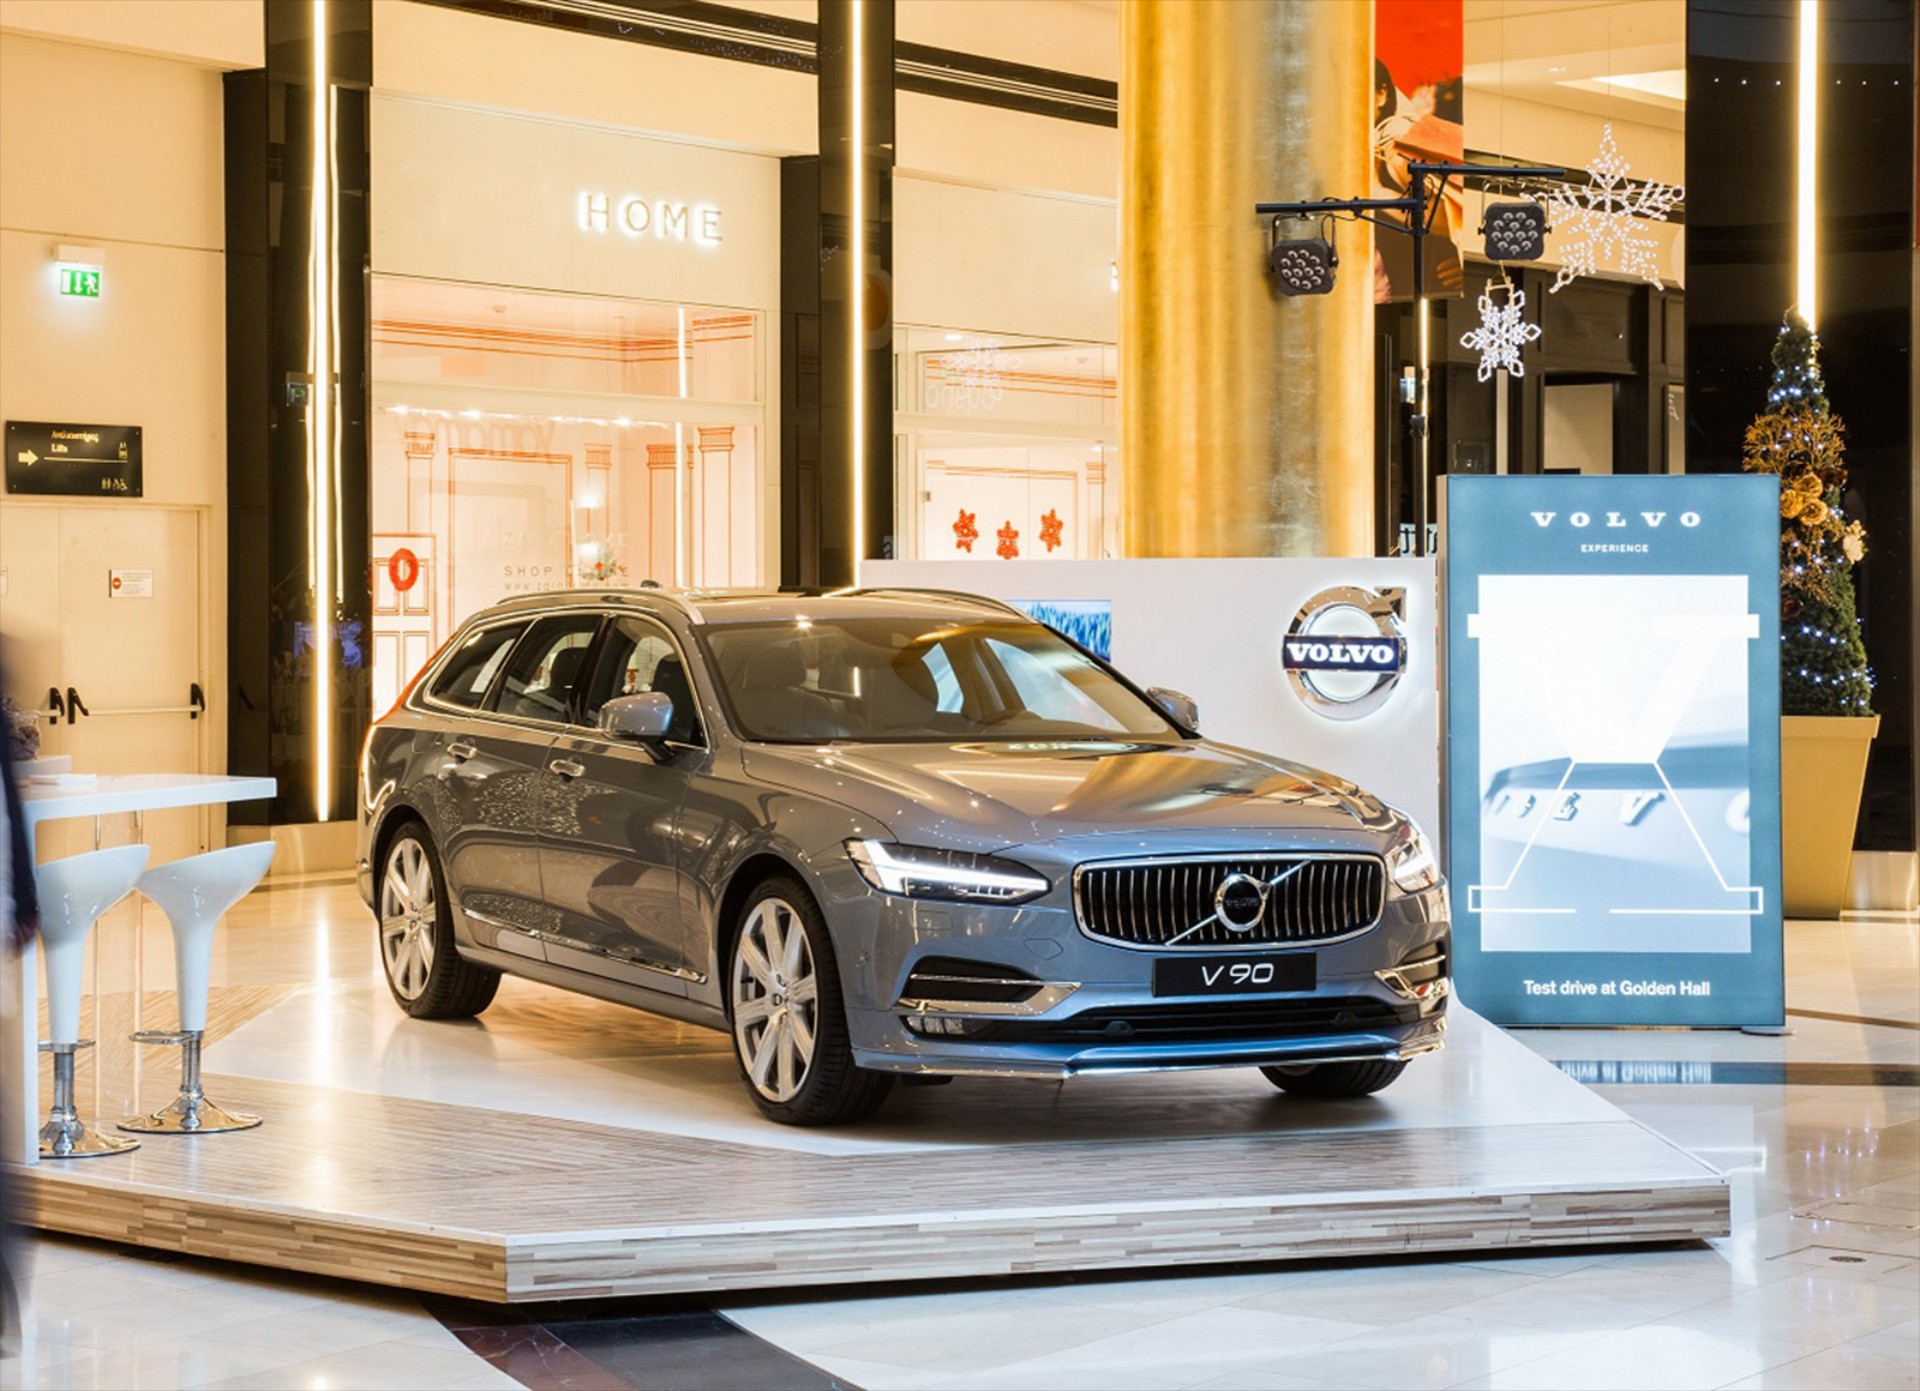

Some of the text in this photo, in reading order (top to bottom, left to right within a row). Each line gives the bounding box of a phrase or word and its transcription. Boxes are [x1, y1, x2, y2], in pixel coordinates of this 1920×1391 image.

[580, 192, 724, 245] HOME
[1530, 511, 1701, 528] VOLVO
[1580, 543, 1649, 553] EXPERIENCE
[504, 565, 553, 577] SHOP
[1286, 643, 1394, 664] VOLVO
[1524, 979, 1710, 996] Test drive at Golden Hall
